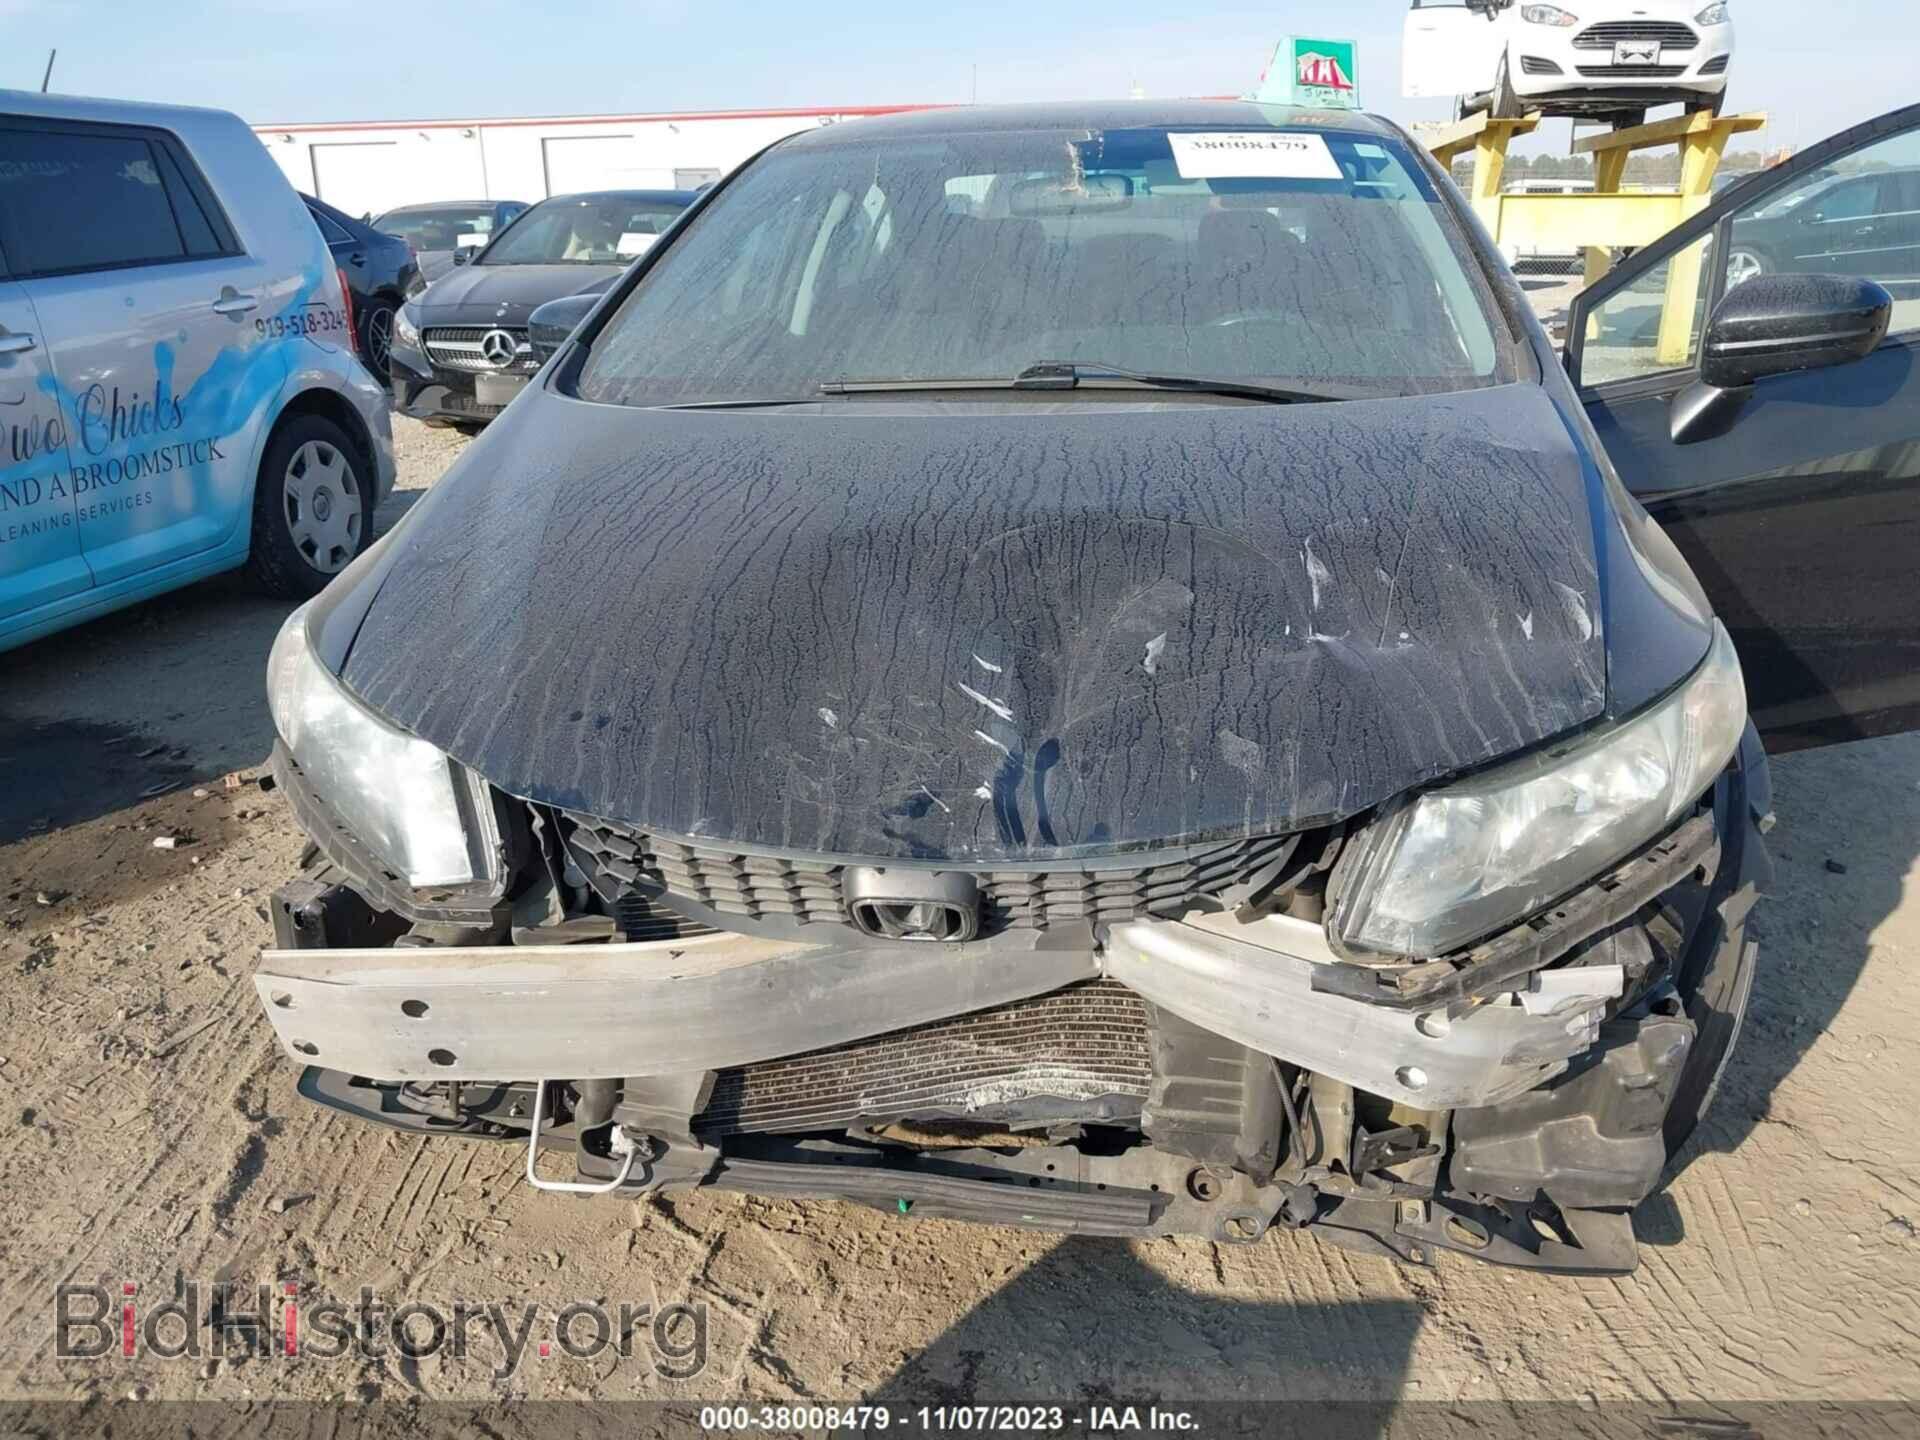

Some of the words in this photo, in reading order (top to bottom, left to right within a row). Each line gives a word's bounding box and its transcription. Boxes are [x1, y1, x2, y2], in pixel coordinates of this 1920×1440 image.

[75, 380, 184, 456] Chicks
[0, 476, 42, 512] ND
[50, 473, 68, 500] A
[72, 435, 225, 493] BROOMSTICK
[80, 491, 153, 522] SERVICES
